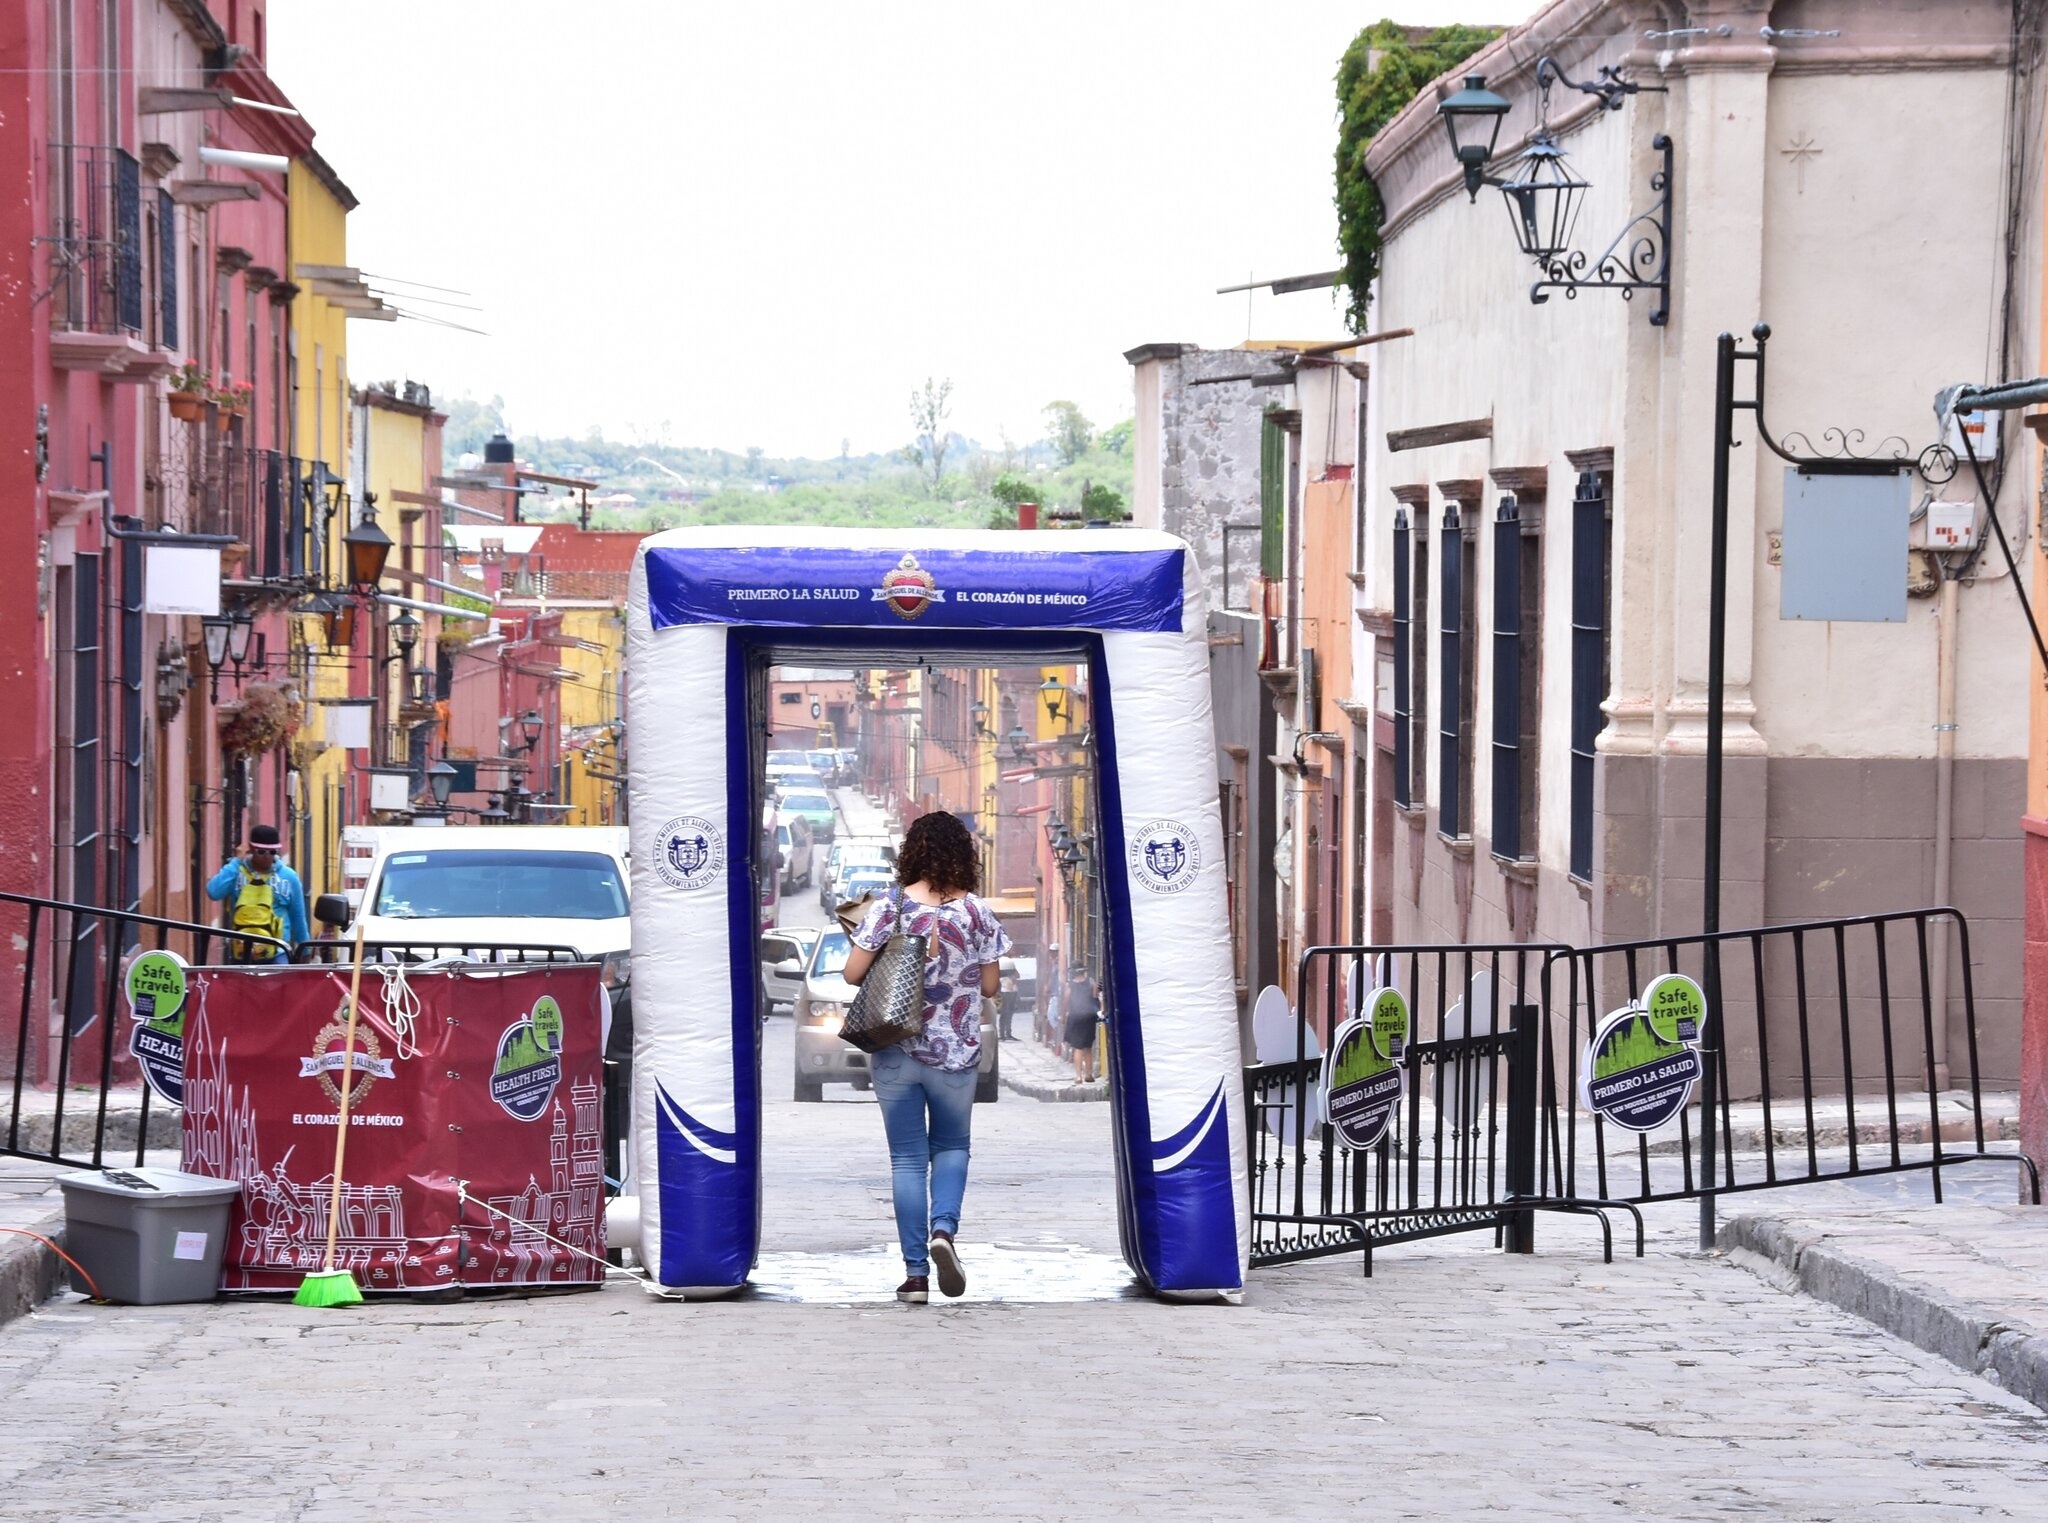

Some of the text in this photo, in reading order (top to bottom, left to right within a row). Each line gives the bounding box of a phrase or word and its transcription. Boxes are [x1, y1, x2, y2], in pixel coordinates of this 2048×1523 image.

[728, 589, 859, 600] PRIMERO LA SALUD
[956, 591, 1087, 605] EL CORAZÓN DE MÉXICO
[142, 964, 171, 980] Safe
[134, 977, 180, 995] travels
[1659, 988, 1687, 1004] Safe
[538, 1007, 553, 1019] Safe
[1380, 1002, 1398, 1018] Safe
[1653, 1001, 1699, 1019] travels
[535, 1020, 558, 1030] travels
[1375, 1017, 1405, 1032] travels
[305, 1062, 319, 1072] SAN
[319, 1056, 344, 1068] MIGUEL
[356, 1058, 386, 1074] ALLENDE
[494, 1064, 557, 1094] HEALTH FIRST
[1594, 1059, 1694, 1100] PRIMERO LA SALUD
[1331, 1078, 1398, 1110] PRIMERO LA SALUD
[292, 1112, 403, 1126] EL CORAZÓ DE MÉXICO
